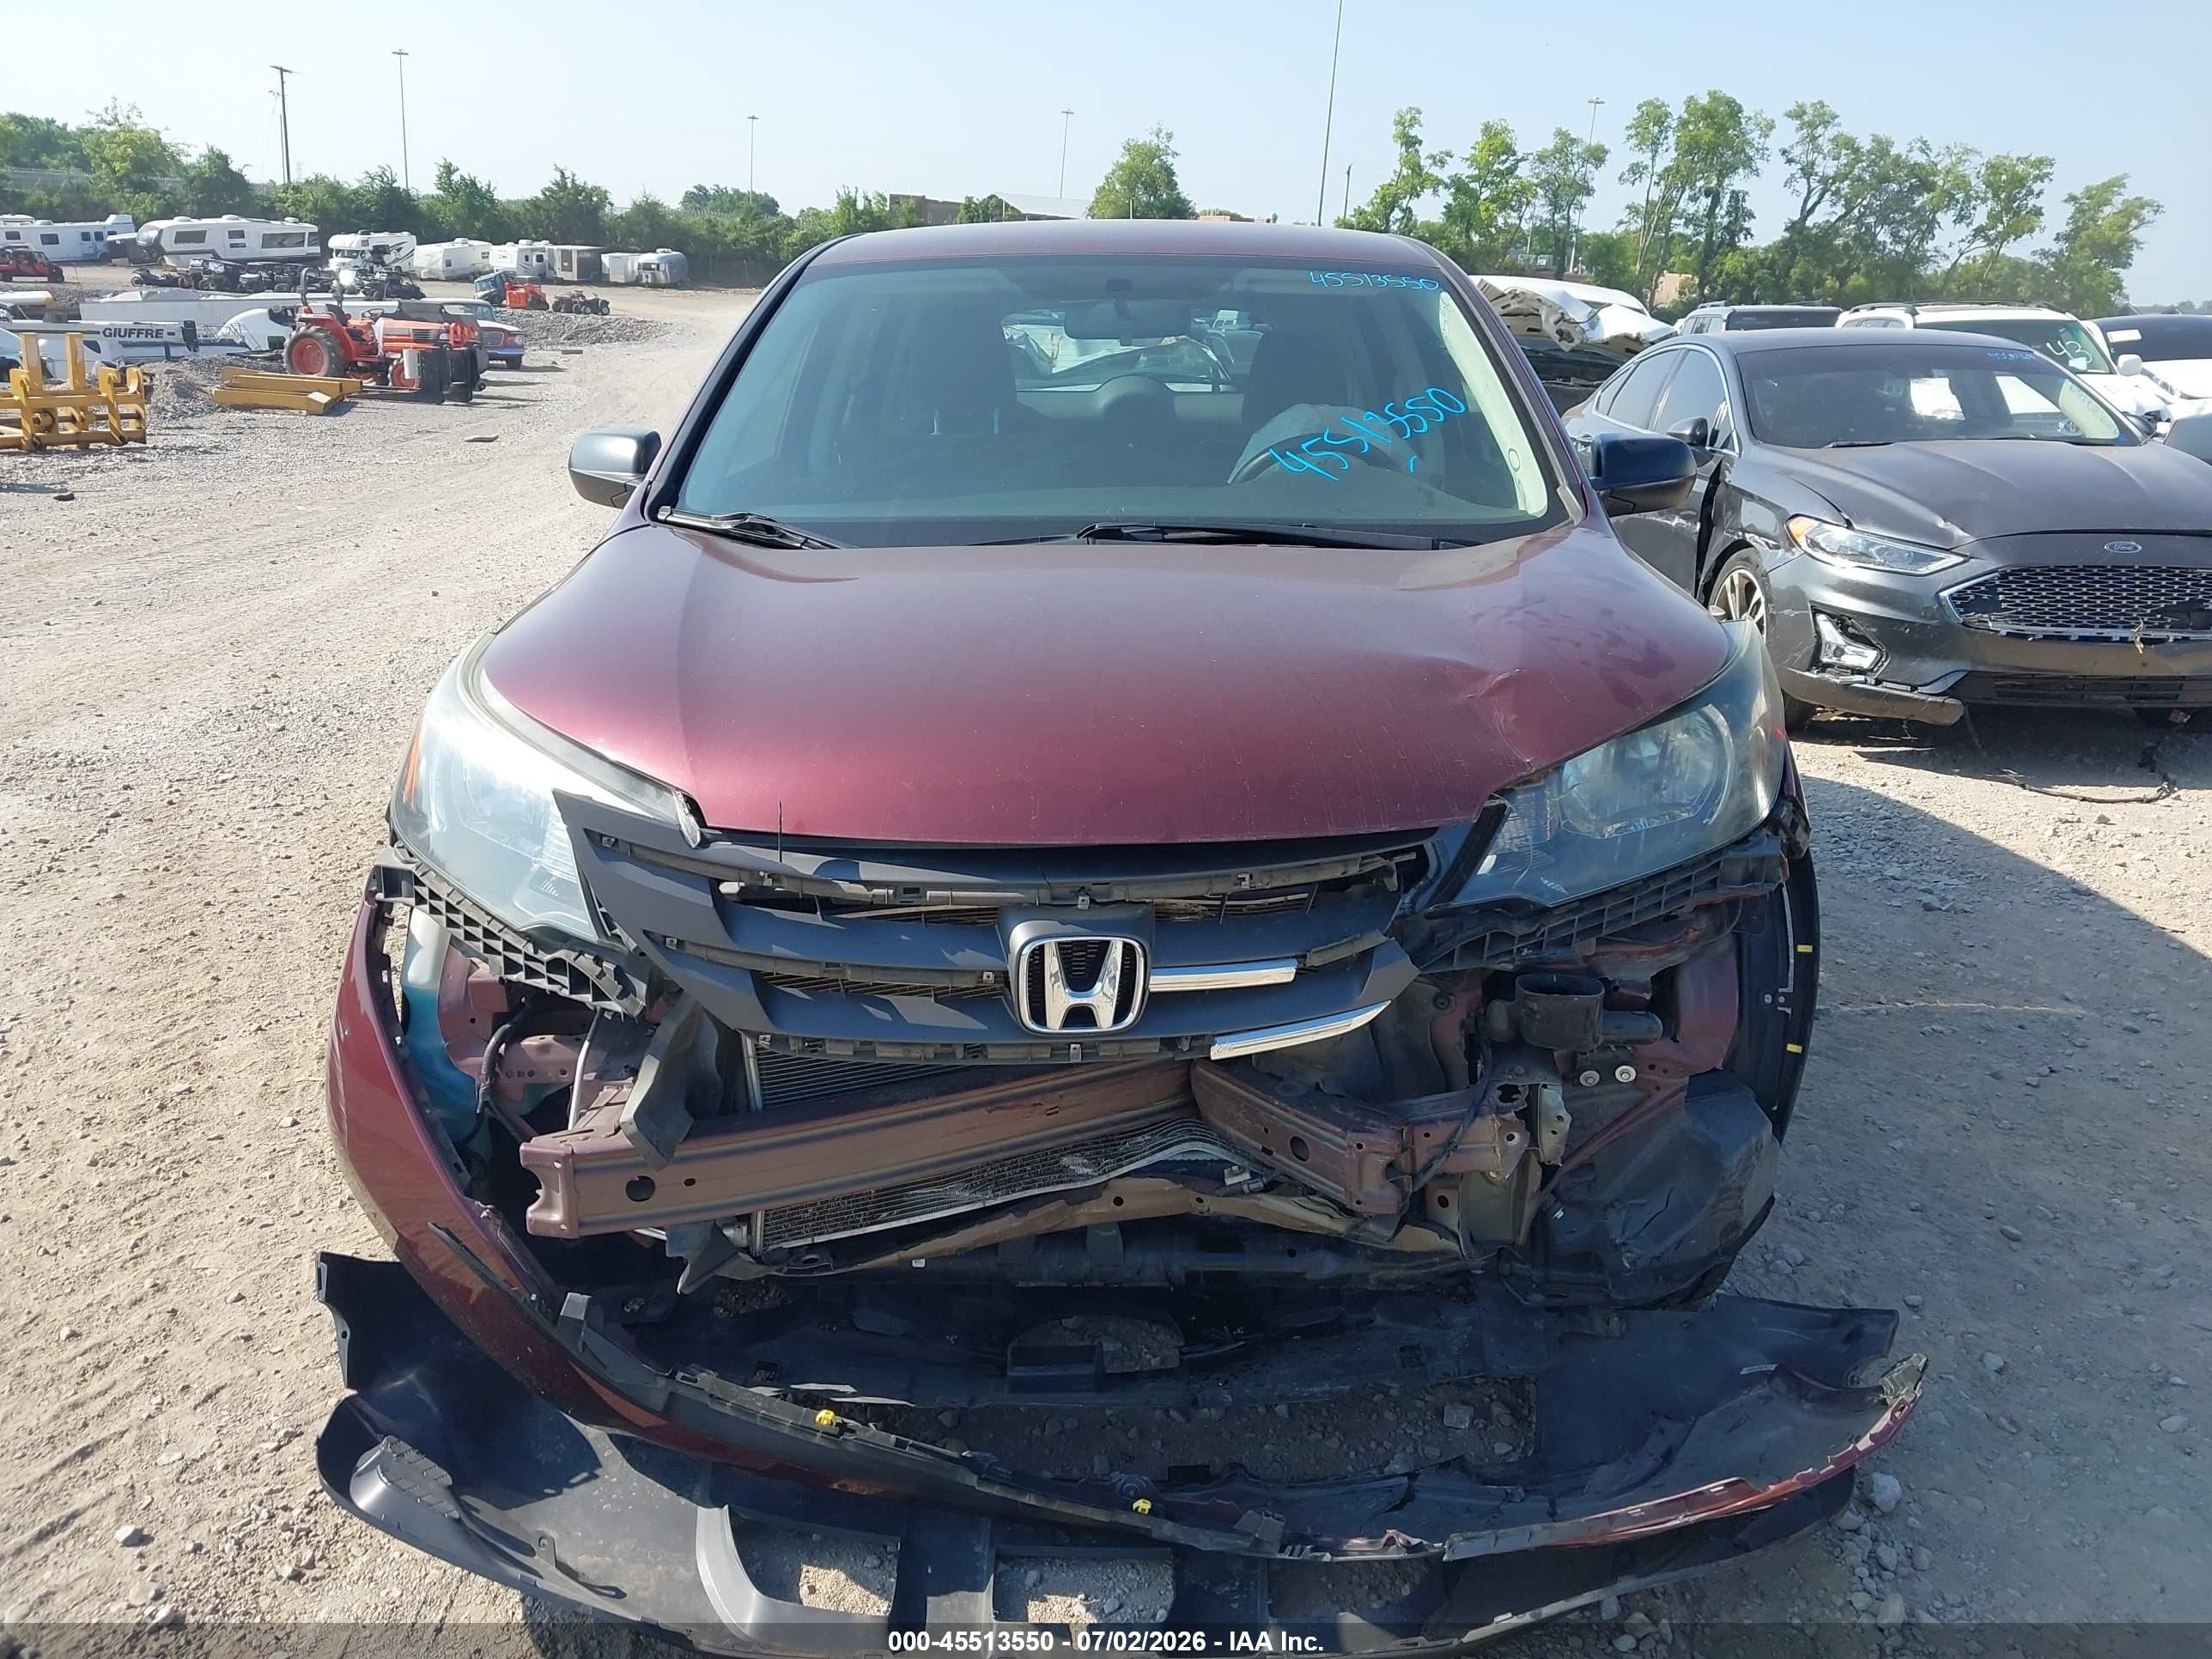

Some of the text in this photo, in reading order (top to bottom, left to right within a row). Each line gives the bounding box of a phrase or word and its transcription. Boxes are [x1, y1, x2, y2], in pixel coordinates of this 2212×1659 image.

[1310, 271, 1439, 291] 45513550
[102, 327, 164, 339] GIUFFRE
[1268, 386, 1466, 481] 45513550
